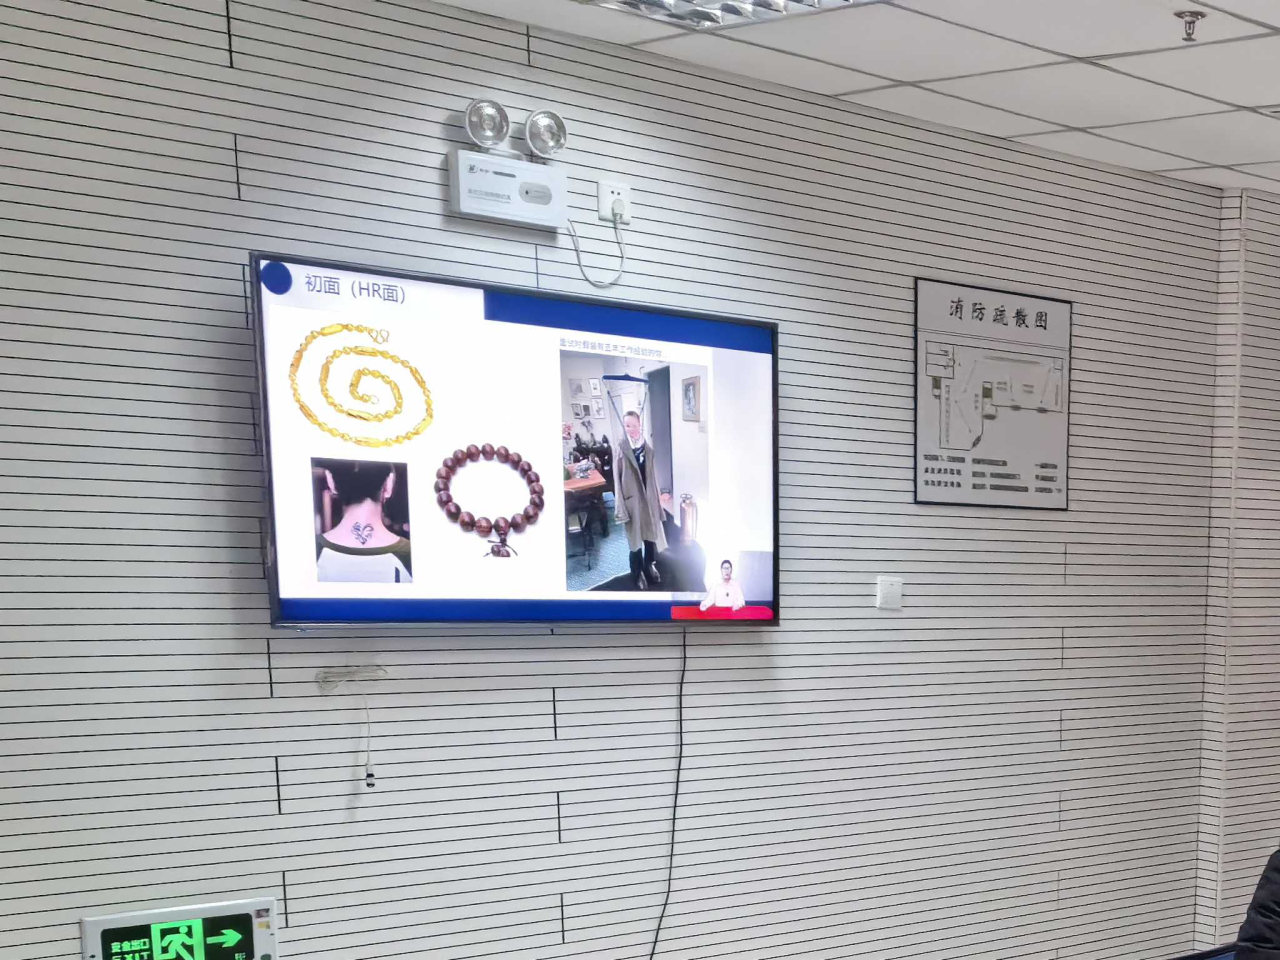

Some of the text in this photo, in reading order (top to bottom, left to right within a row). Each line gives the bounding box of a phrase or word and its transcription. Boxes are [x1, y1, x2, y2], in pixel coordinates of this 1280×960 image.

[949, 297, 1048, 330] 消防疏散图
[111, 938, 149, 953] 安全出口
